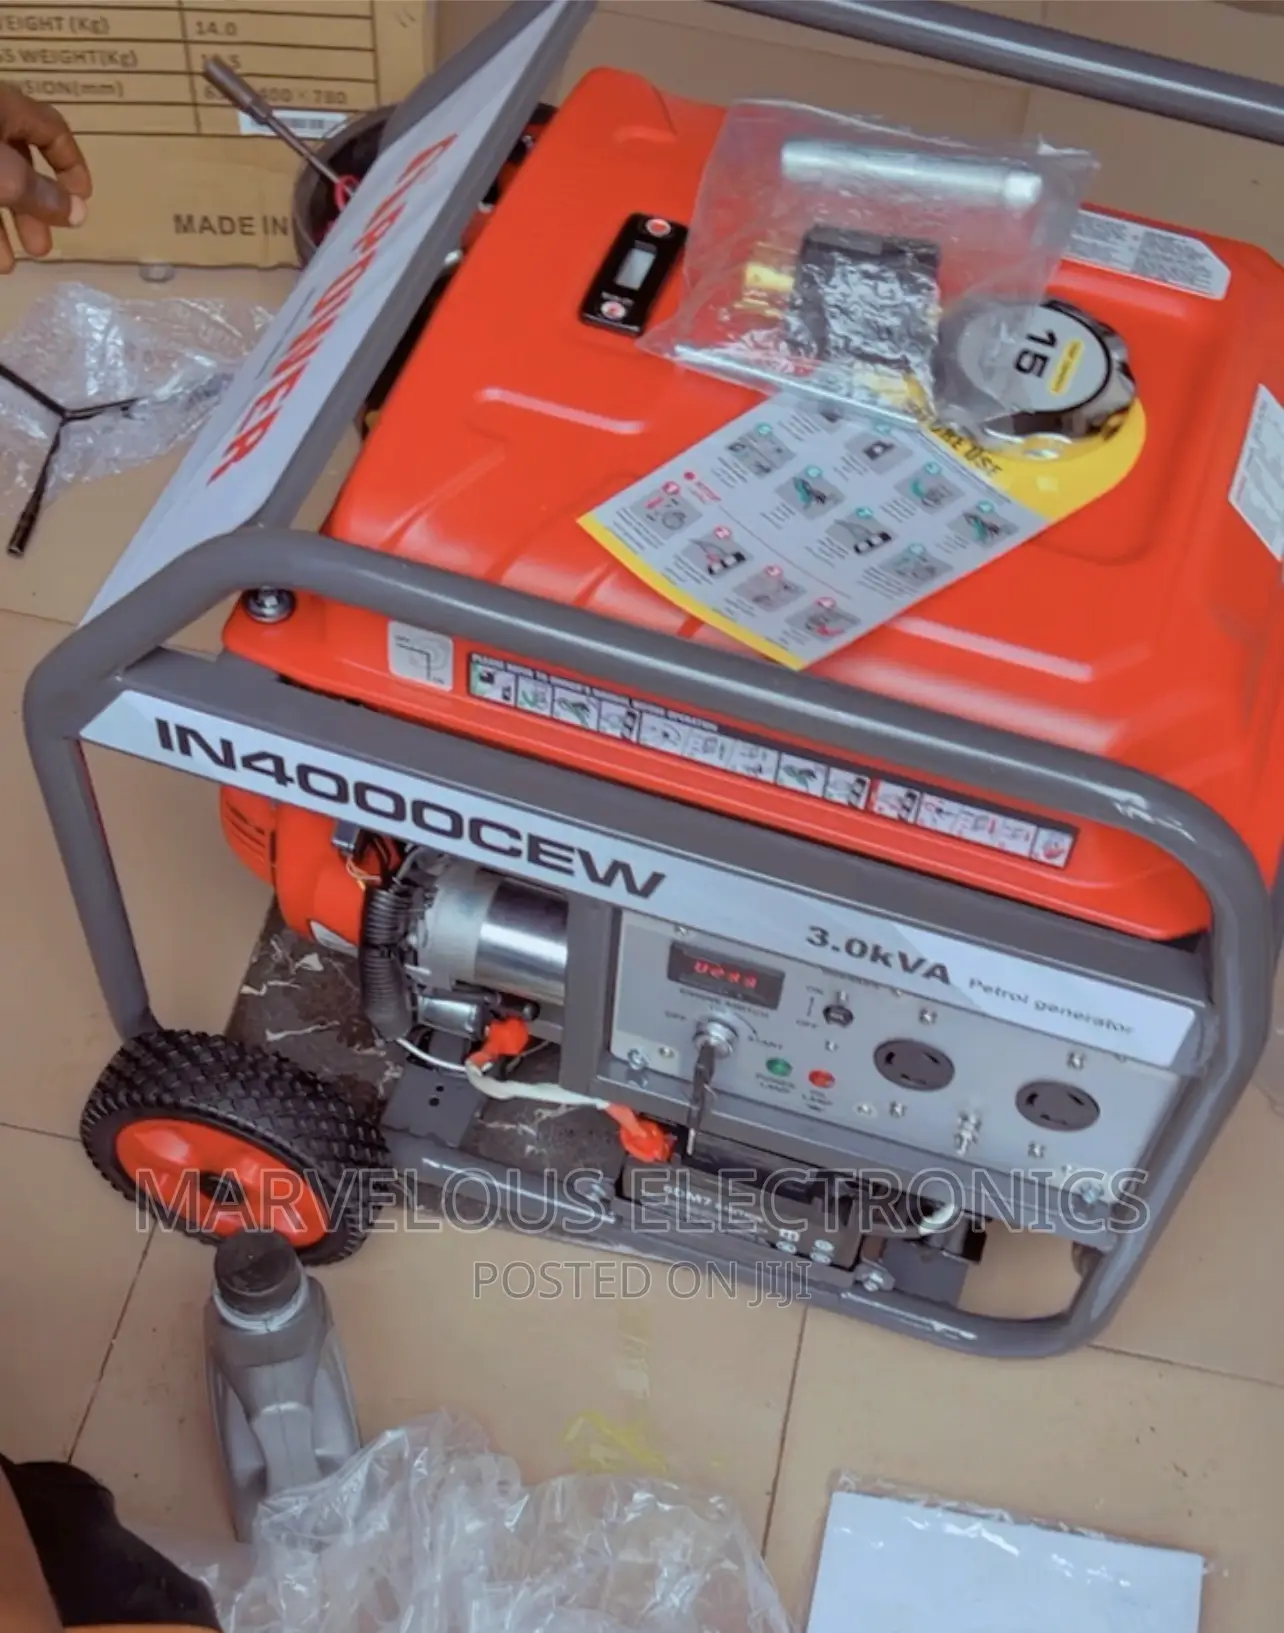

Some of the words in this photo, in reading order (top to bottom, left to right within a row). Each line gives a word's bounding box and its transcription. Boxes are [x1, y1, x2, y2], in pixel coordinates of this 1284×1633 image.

[0, 15, 65, 31] EIGHT
[173, 213, 257, 236] MADE
[262, 215, 289, 235] IN
[155, 718, 666, 899] IN4000CEW
[806, 925, 951, 985] 3.0kVA
[968, 976, 1029, 1006] Petrol
[1032, 997, 1136, 1036] generator
